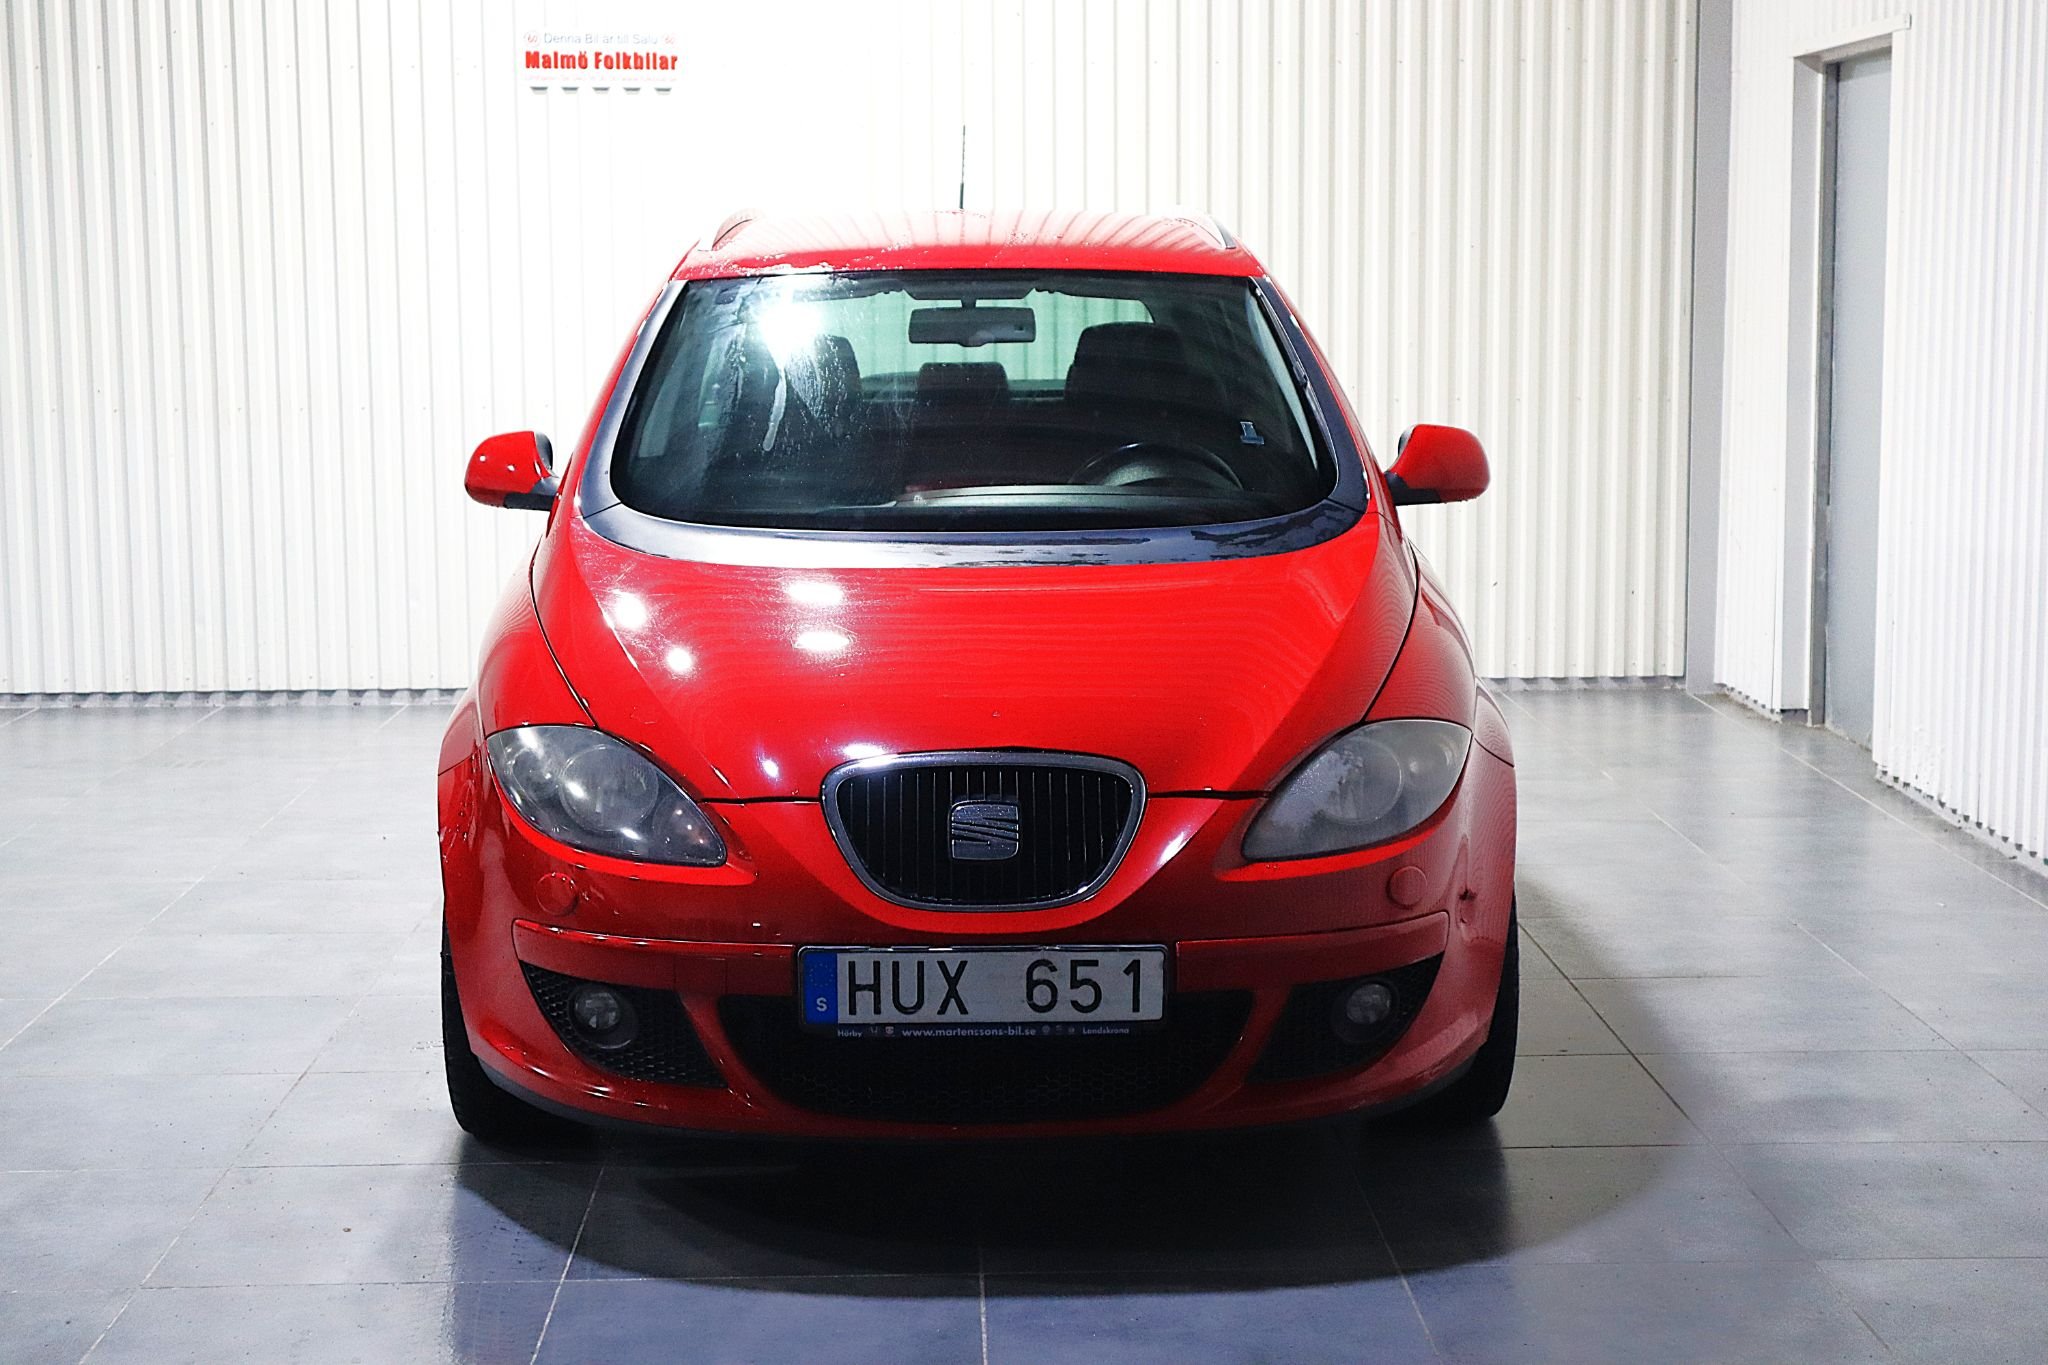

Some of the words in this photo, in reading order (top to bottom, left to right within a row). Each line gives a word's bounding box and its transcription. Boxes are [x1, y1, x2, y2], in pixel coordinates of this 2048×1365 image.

[544, 33, 581, 44] Denna
[632, 33, 658, 45] Salu
[525, 51, 588, 69] Malmö
[595, 51, 678, 70] Folkbilar
[848, 960, 968, 1015] HUX
[1026, 958, 1141, 1014] 651
[816, 998, 827, 1011] S
[837, 1030, 863, 1038] Hörby
[1082, 1026, 1129, 1034] Landskrona
